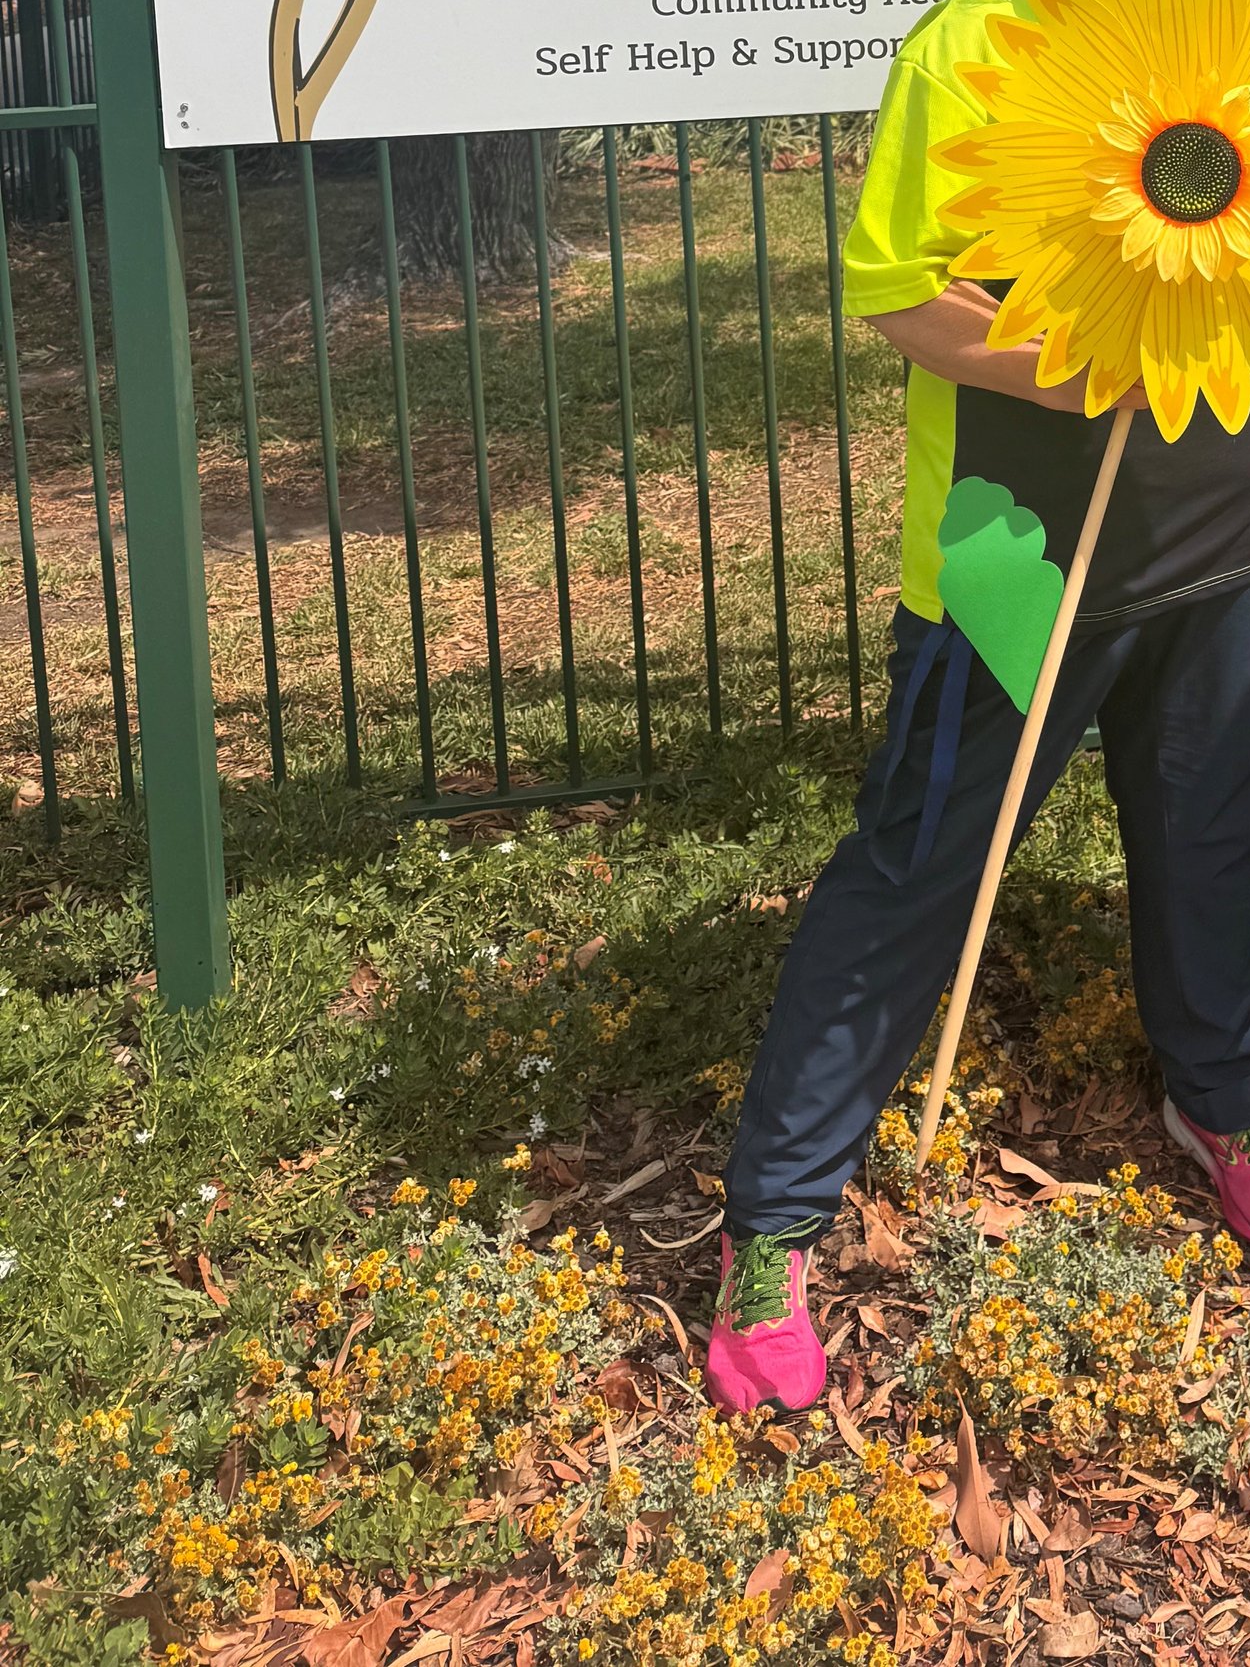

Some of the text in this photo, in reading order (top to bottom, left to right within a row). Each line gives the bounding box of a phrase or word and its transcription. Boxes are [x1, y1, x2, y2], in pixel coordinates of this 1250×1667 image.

[536, 36, 904, 76] Self Help & Suppor
